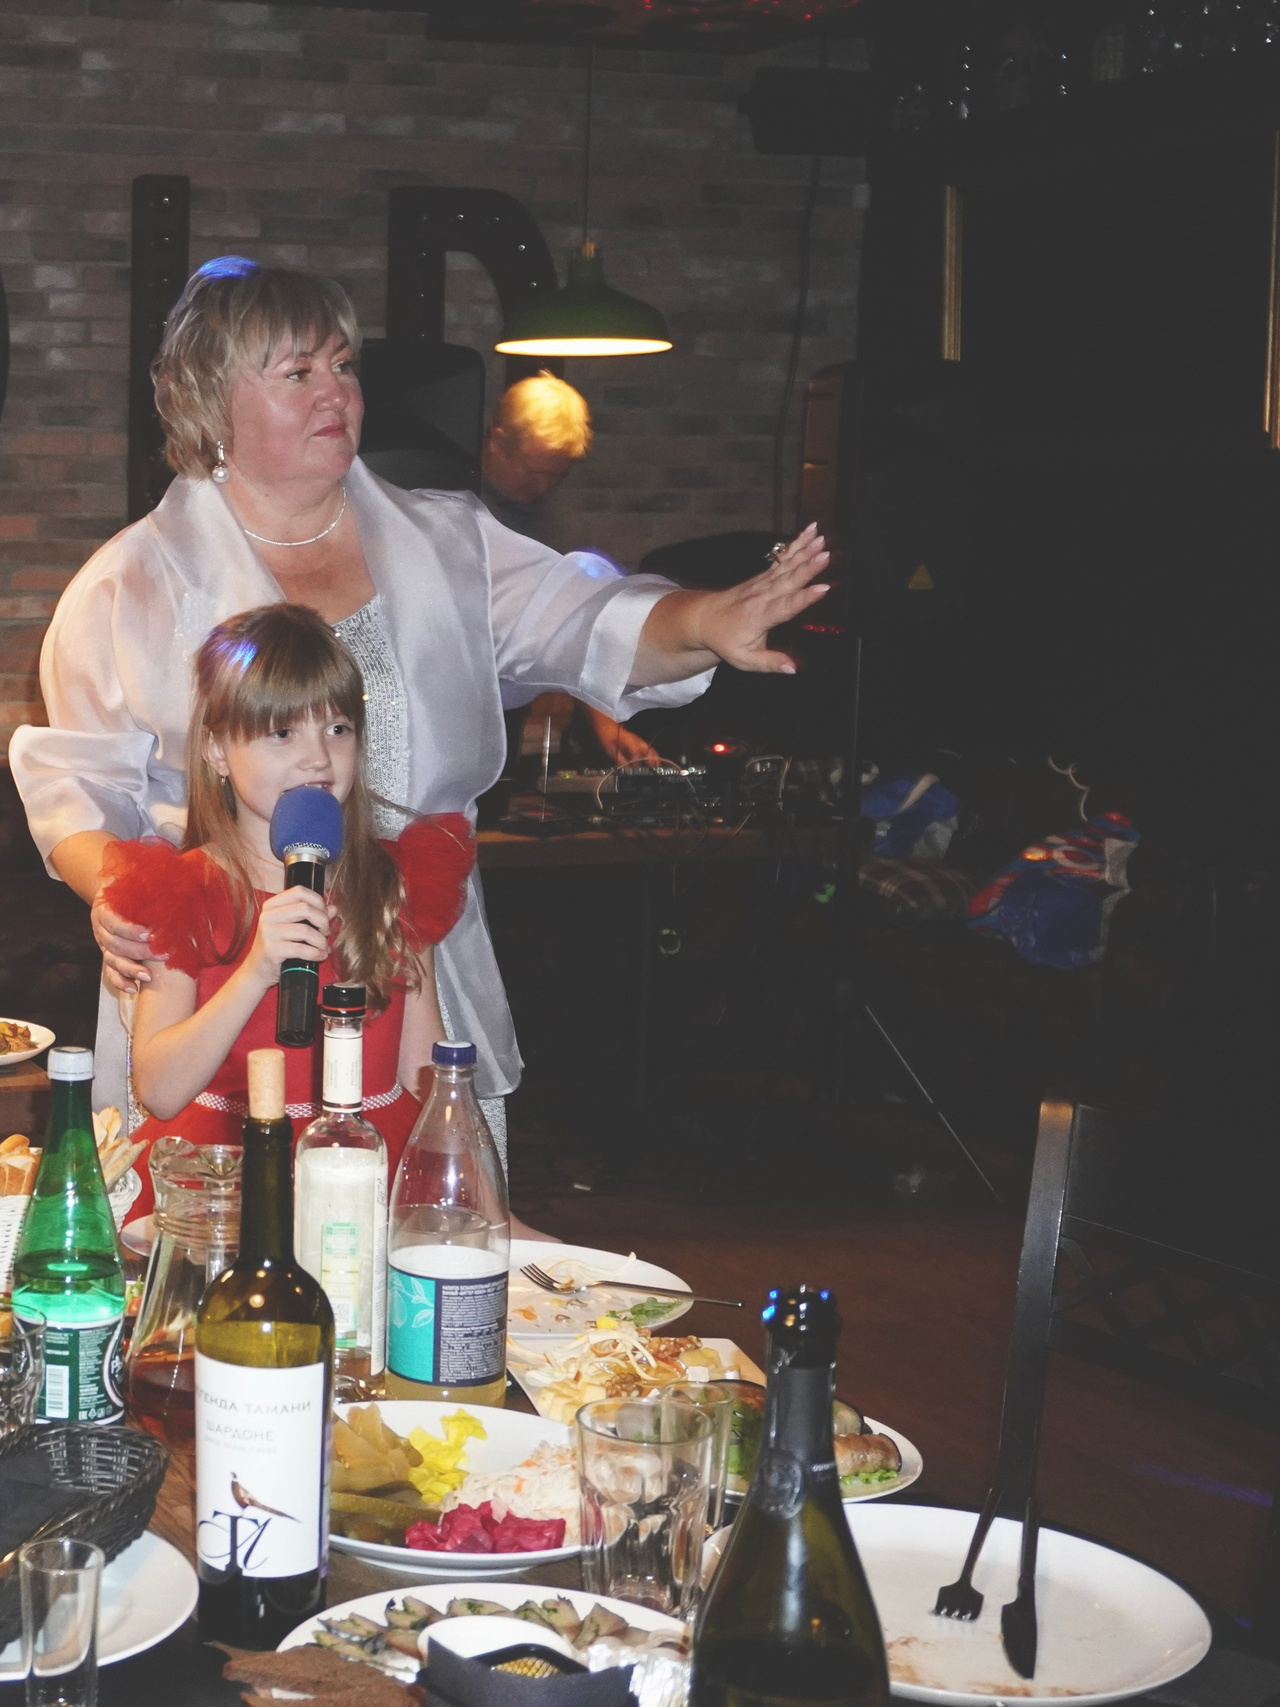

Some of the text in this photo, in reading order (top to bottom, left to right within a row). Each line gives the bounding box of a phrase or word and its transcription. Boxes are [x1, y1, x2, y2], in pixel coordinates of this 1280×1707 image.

[198, 1388, 312, 1415] ГЕНДА ТАМАНИ
[206, 1419, 275, 1442] ШАРДОНЕ
